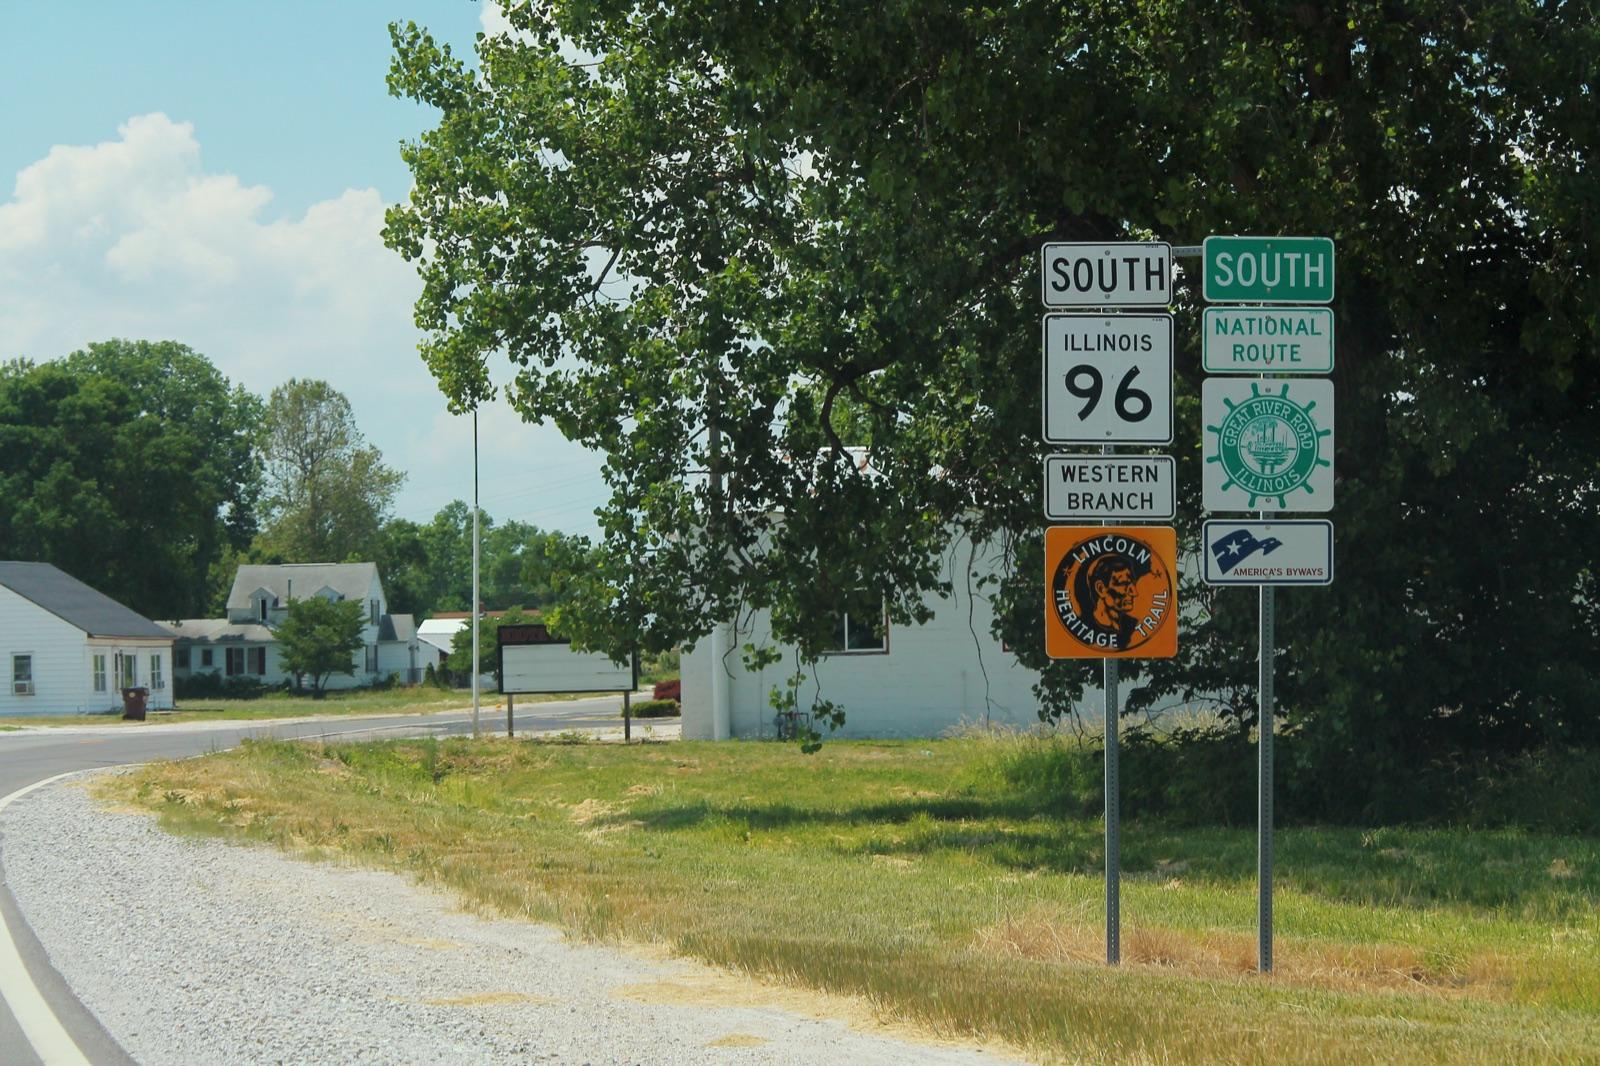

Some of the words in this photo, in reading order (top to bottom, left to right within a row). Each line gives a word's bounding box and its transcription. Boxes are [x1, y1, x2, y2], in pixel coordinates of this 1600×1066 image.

[1051, 257, 1165, 292] SOUTH
[1214, 251, 1324, 287] SOUTH
[1215, 318, 1322, 336] NATIONAL
[1064, 334, 1152, 351] ILLINOIS
[1232, 344, 1301, 362] ROUTE
[1065, 364, 1152, 422] 96
[1224, 408, 1251, 447] GREAT
[1252, 401, 1291, 418] RIVER
[1291, 413, 1313, 449] ROAD
[1061, 465, 1158, 483] WESTERN
[1235, 469, 1300, 491] ILLINOIS
[1068, 492, 1153, 510] BRANCH
[1072, 538, 1150, 564] LINCOLN
[1233, 567, 1283, 577] AMERICA'S
[1286, 567, 1323, 576] BYWAYS
[1056, 589, 1118, 647] HERITAGE
[1135, 590, 1168, 637] TRAIL
